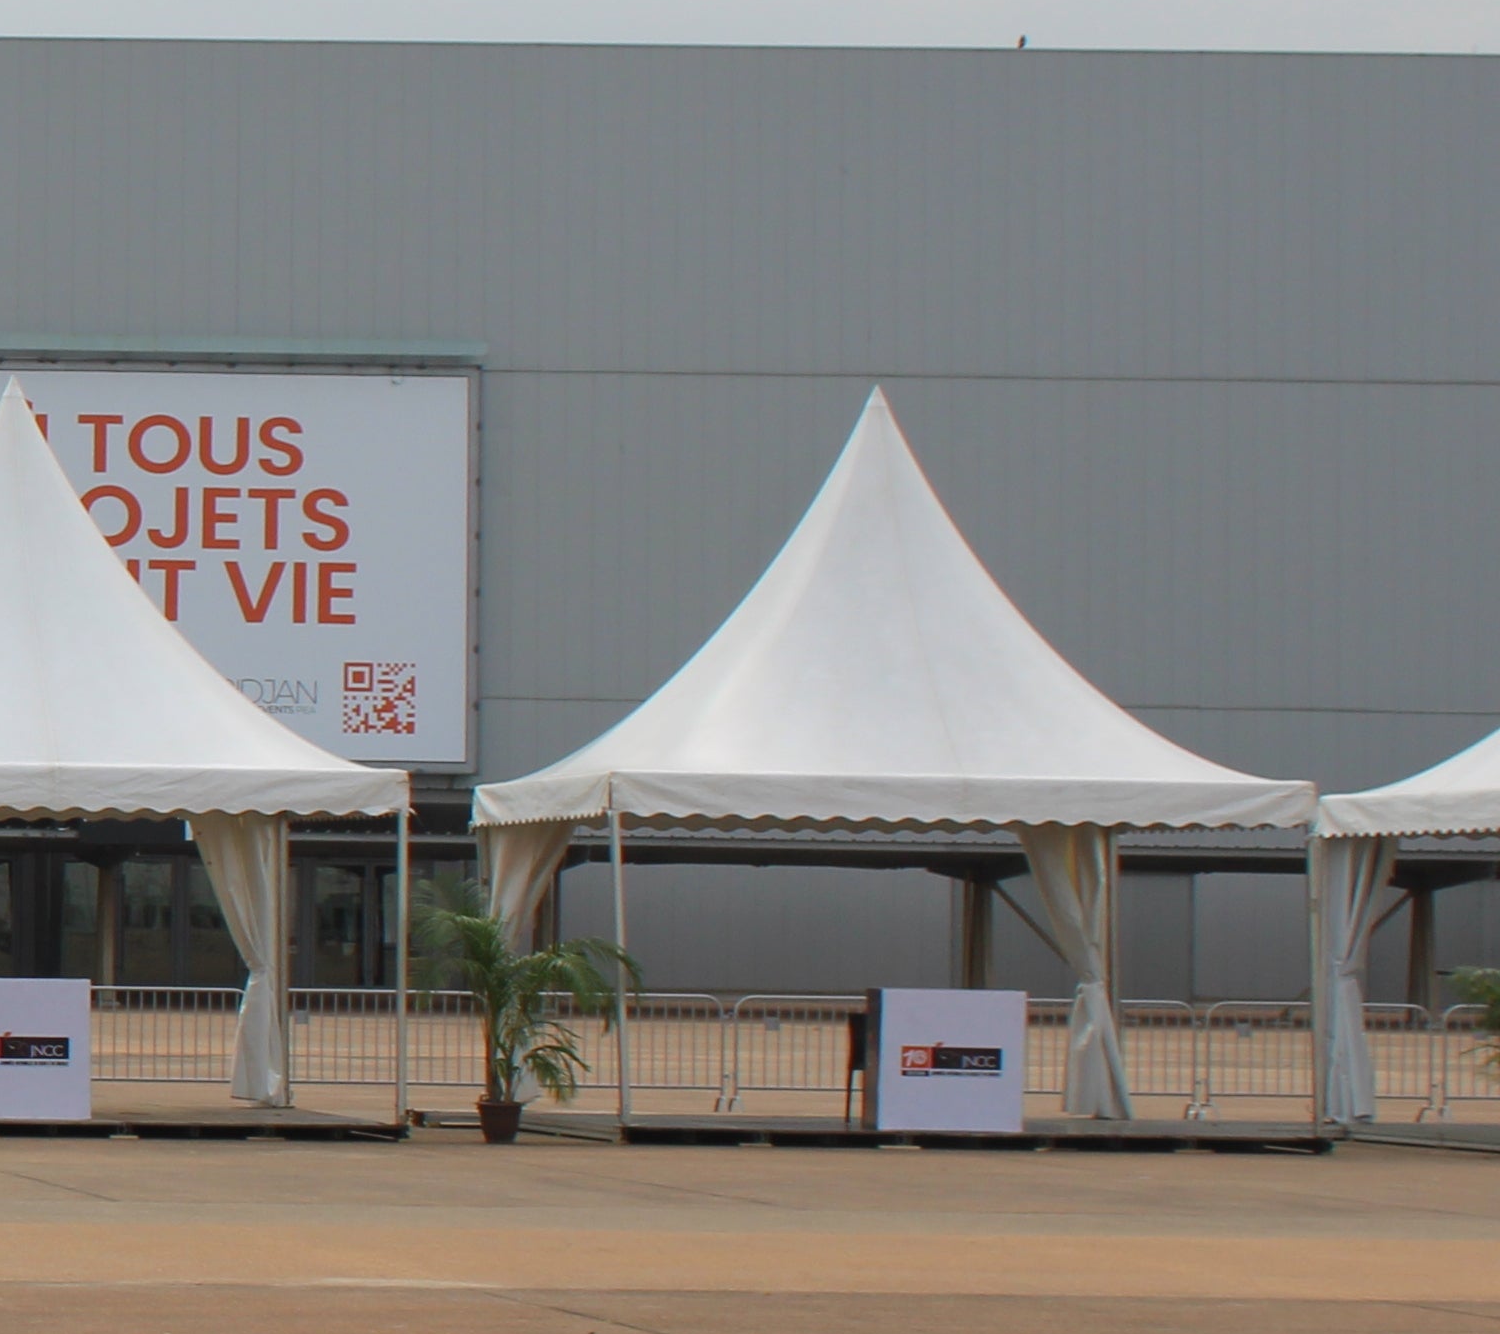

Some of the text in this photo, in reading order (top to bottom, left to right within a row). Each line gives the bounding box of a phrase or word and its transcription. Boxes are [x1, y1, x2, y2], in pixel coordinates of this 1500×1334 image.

[78, 413, 304, 476] TOUS
[80, 485, 350, 552] OJETS
[224, 560, 357, 625] VIE
